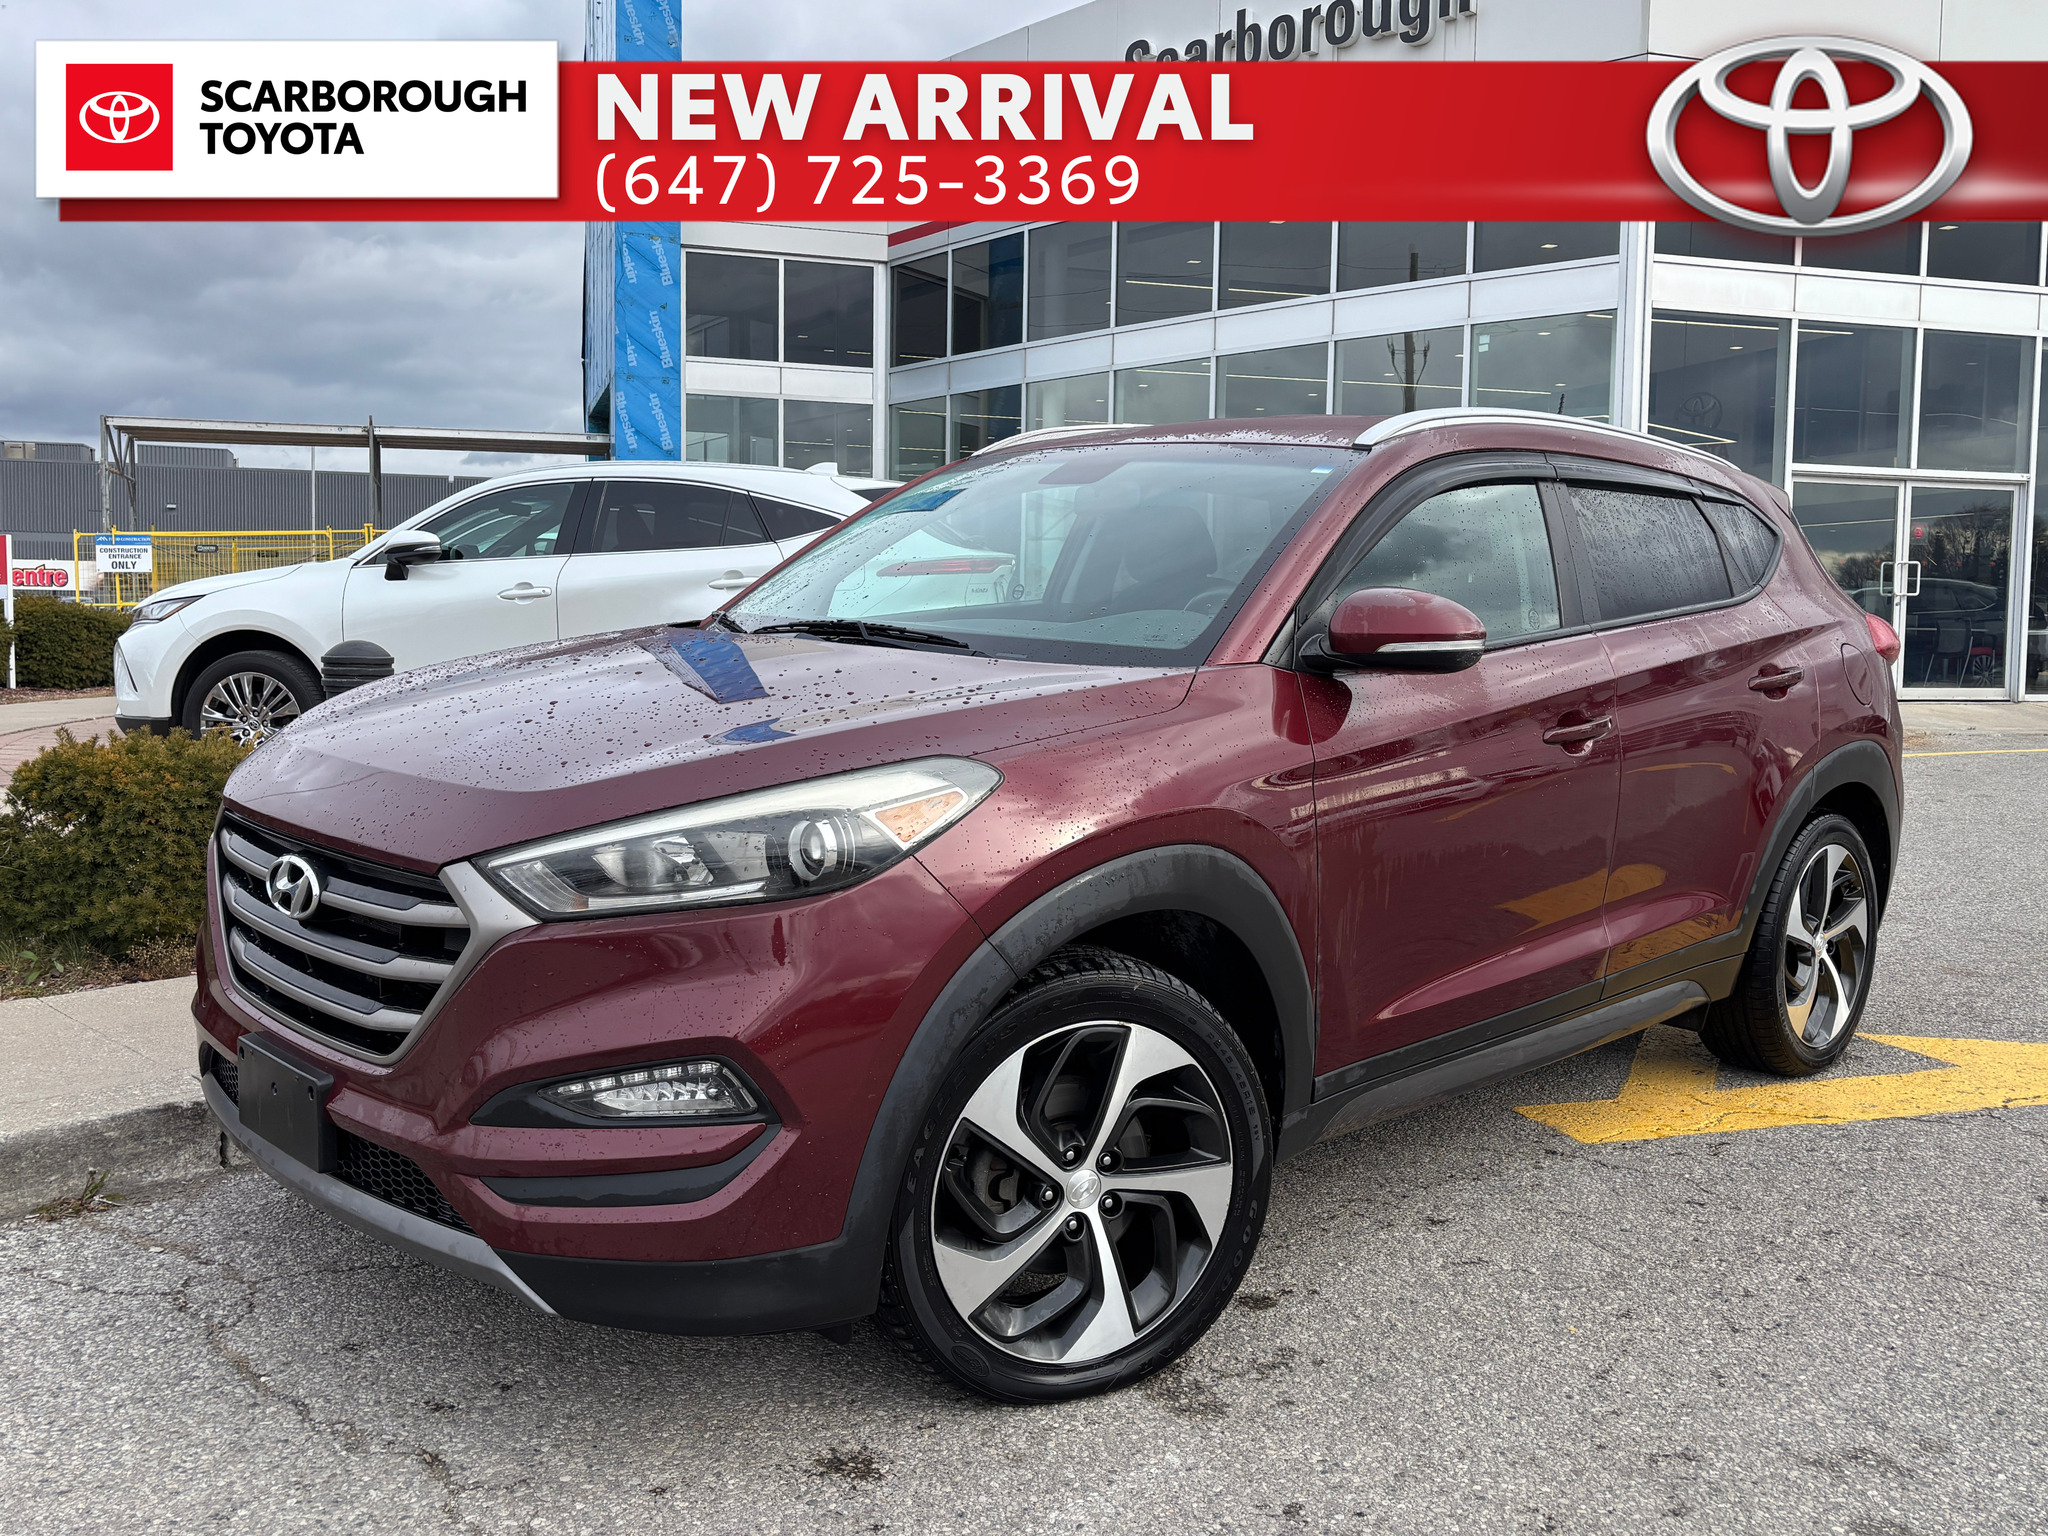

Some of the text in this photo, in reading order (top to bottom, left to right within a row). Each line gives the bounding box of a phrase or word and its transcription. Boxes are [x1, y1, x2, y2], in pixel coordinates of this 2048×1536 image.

[649, 310, 673, 368] Blueskin
[616, 391, 638, 450] Blueskin
[649, 392, 674, 450] Blueskin
[111, 560, 137, 570] ONLY
